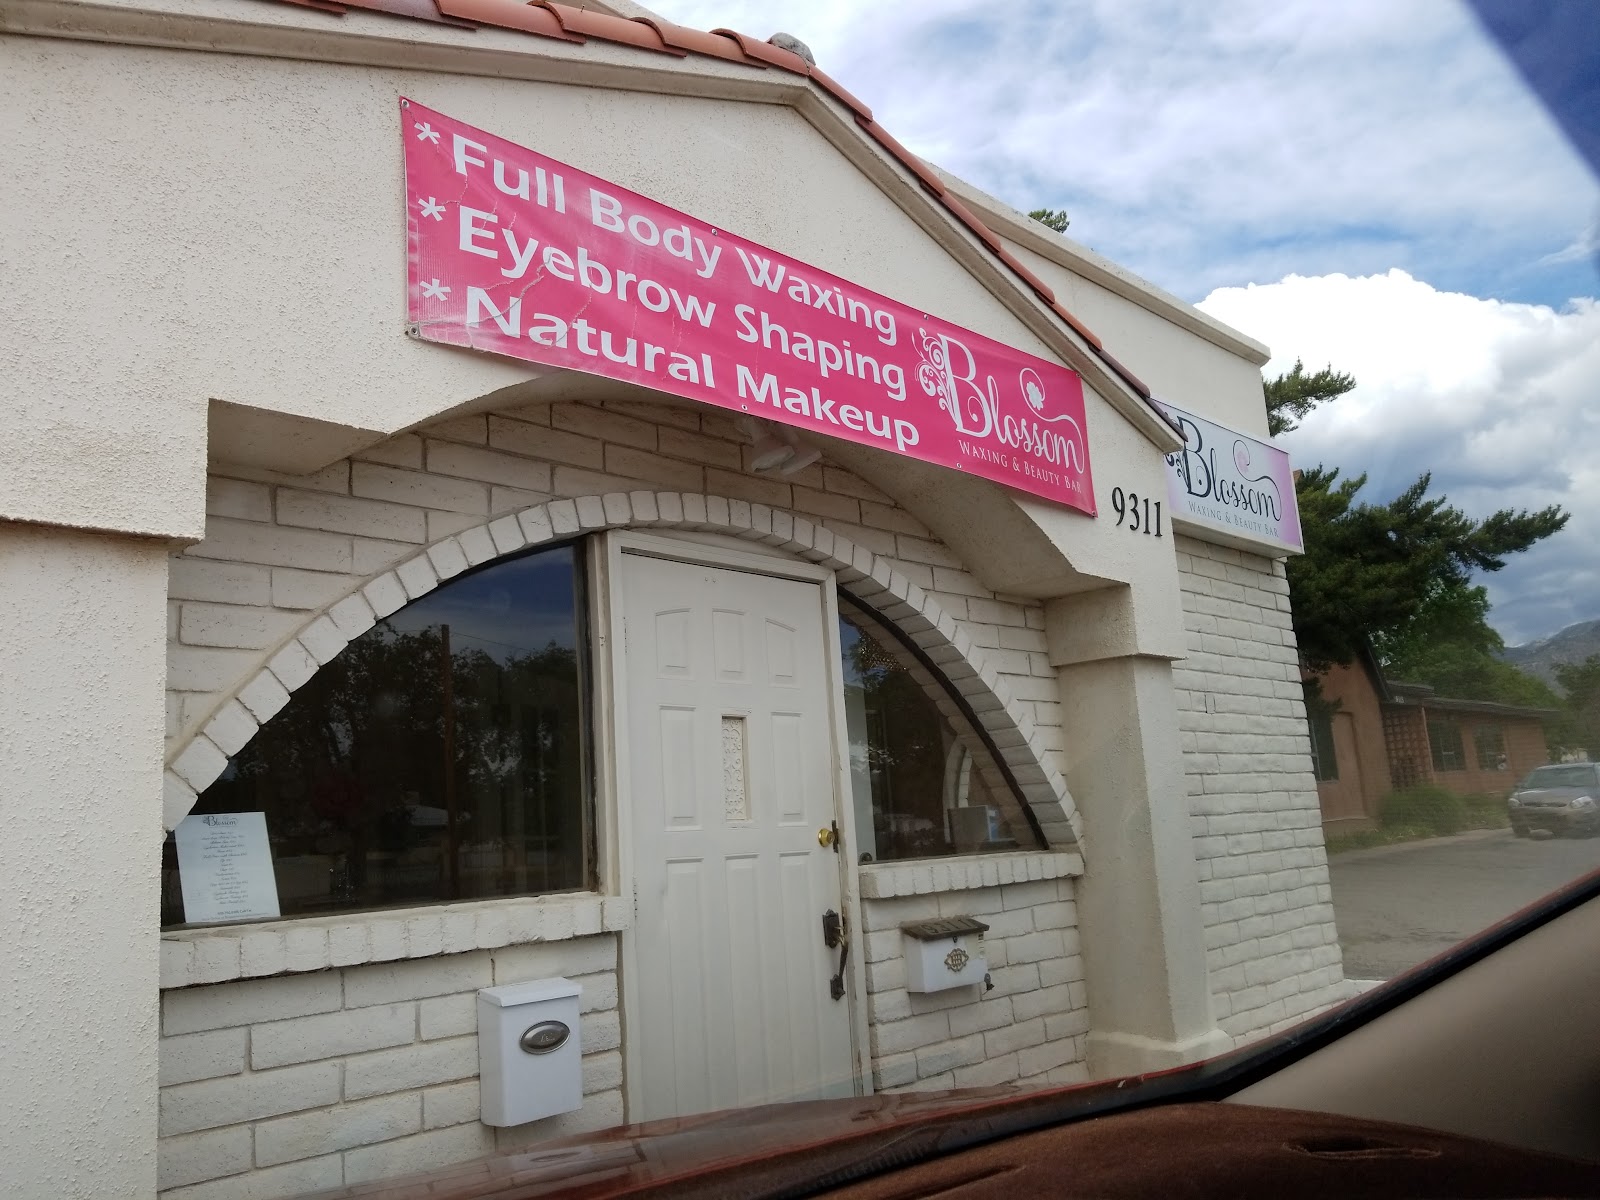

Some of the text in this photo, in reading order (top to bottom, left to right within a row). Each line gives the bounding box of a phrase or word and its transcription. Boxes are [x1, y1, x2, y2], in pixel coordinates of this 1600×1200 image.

[453, 133, 897, 346] Full Body Waxing
[459, 205, 907, 401] Eyebrow Shaping
[465, 286, 919, 451] Natural Makeup
[913, 328, 1084, 474] Blossom
[958, 439, 1082, 494] WAXING & BEAUTY BAR
[1111, 486, 1163, 538] 9311
[1170, 415, 1282, 521] Blossom
[1225, 511, 1232, 524] &
